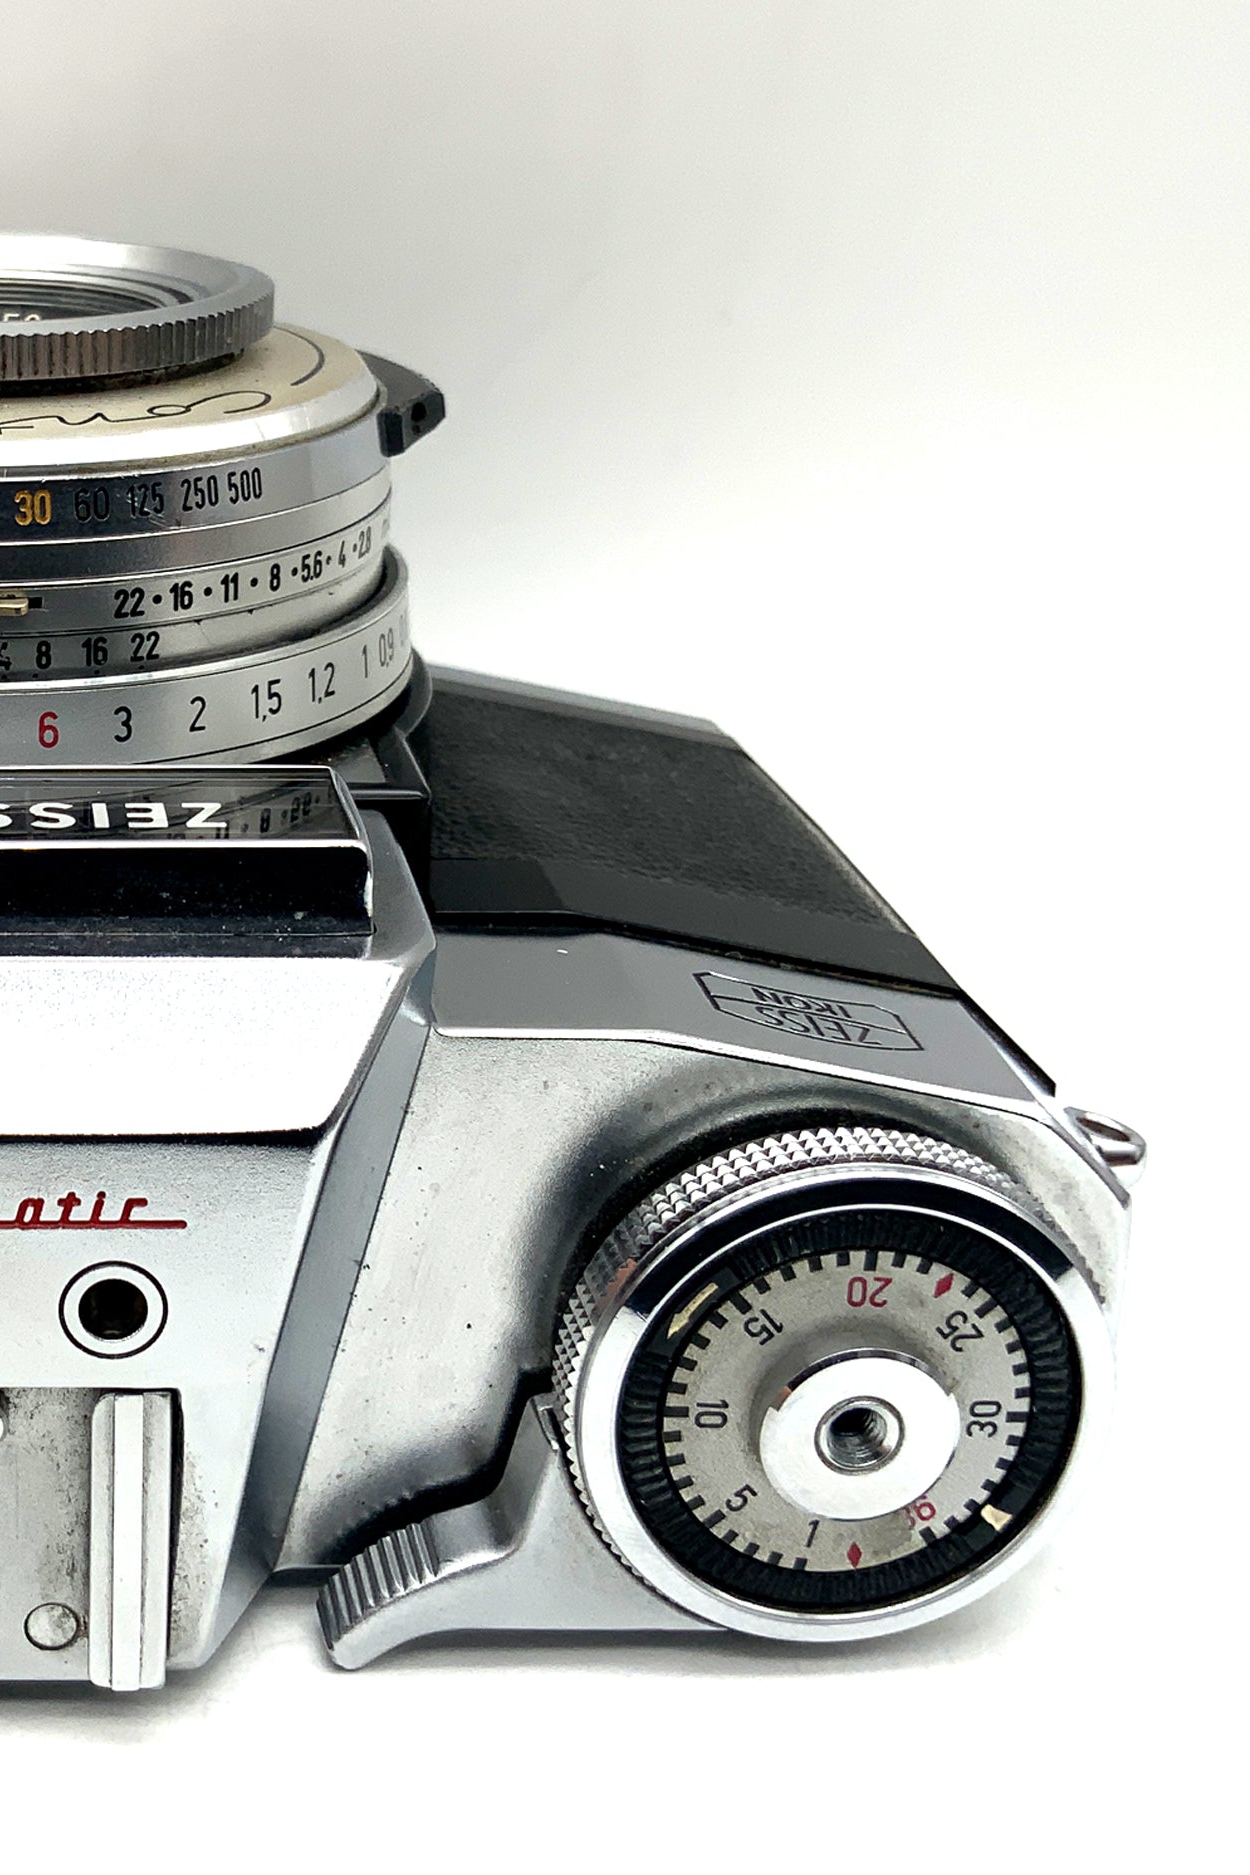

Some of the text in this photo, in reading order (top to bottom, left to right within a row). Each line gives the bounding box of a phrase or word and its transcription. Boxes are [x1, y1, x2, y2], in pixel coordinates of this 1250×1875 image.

[14, 489, 52, 525] 30
[73, 487, 111, 523] 60
[126, 485, 165, 518] 125
[181, 478, 220, 512] 250
[228, 467, 263, 504] 500
[114, 588, 146, 619] 22
[169, 580, 194, 611] 16
[221, 572, 240, 603] 11
[269, 562, 282, 592] 8
[301, 550, 323, 583] 5.6
[337, 540, 347, 568] 4
[36, 640, 51, 670] 8
[82, 637, 108, 668] 16
[130, 631, 159, 662] 22
[38, 712, 59, 749] 6
[114, 706, 133, 743] 3
[189, 697, 206, 732] 2
[251, 680, 282, 722] 1,5
[308, 662, 336, 704] 1,2
[361, 644, 369, 679] 1
[752, 987, 852, 1019] IKON
[755, 1006, 881, 1046] ZEISS
[846, 1275, 893, 1308] 20
[743, 1309, 784, 1346] 15
[936, 1310, 984, 1353] 25
[694, 1399, 729, 1430] 10
[966, 1400, 1003, 1439] 30
[725, 1484, 758, 1513] 5
[807, 1519, 820, 1548] 1
